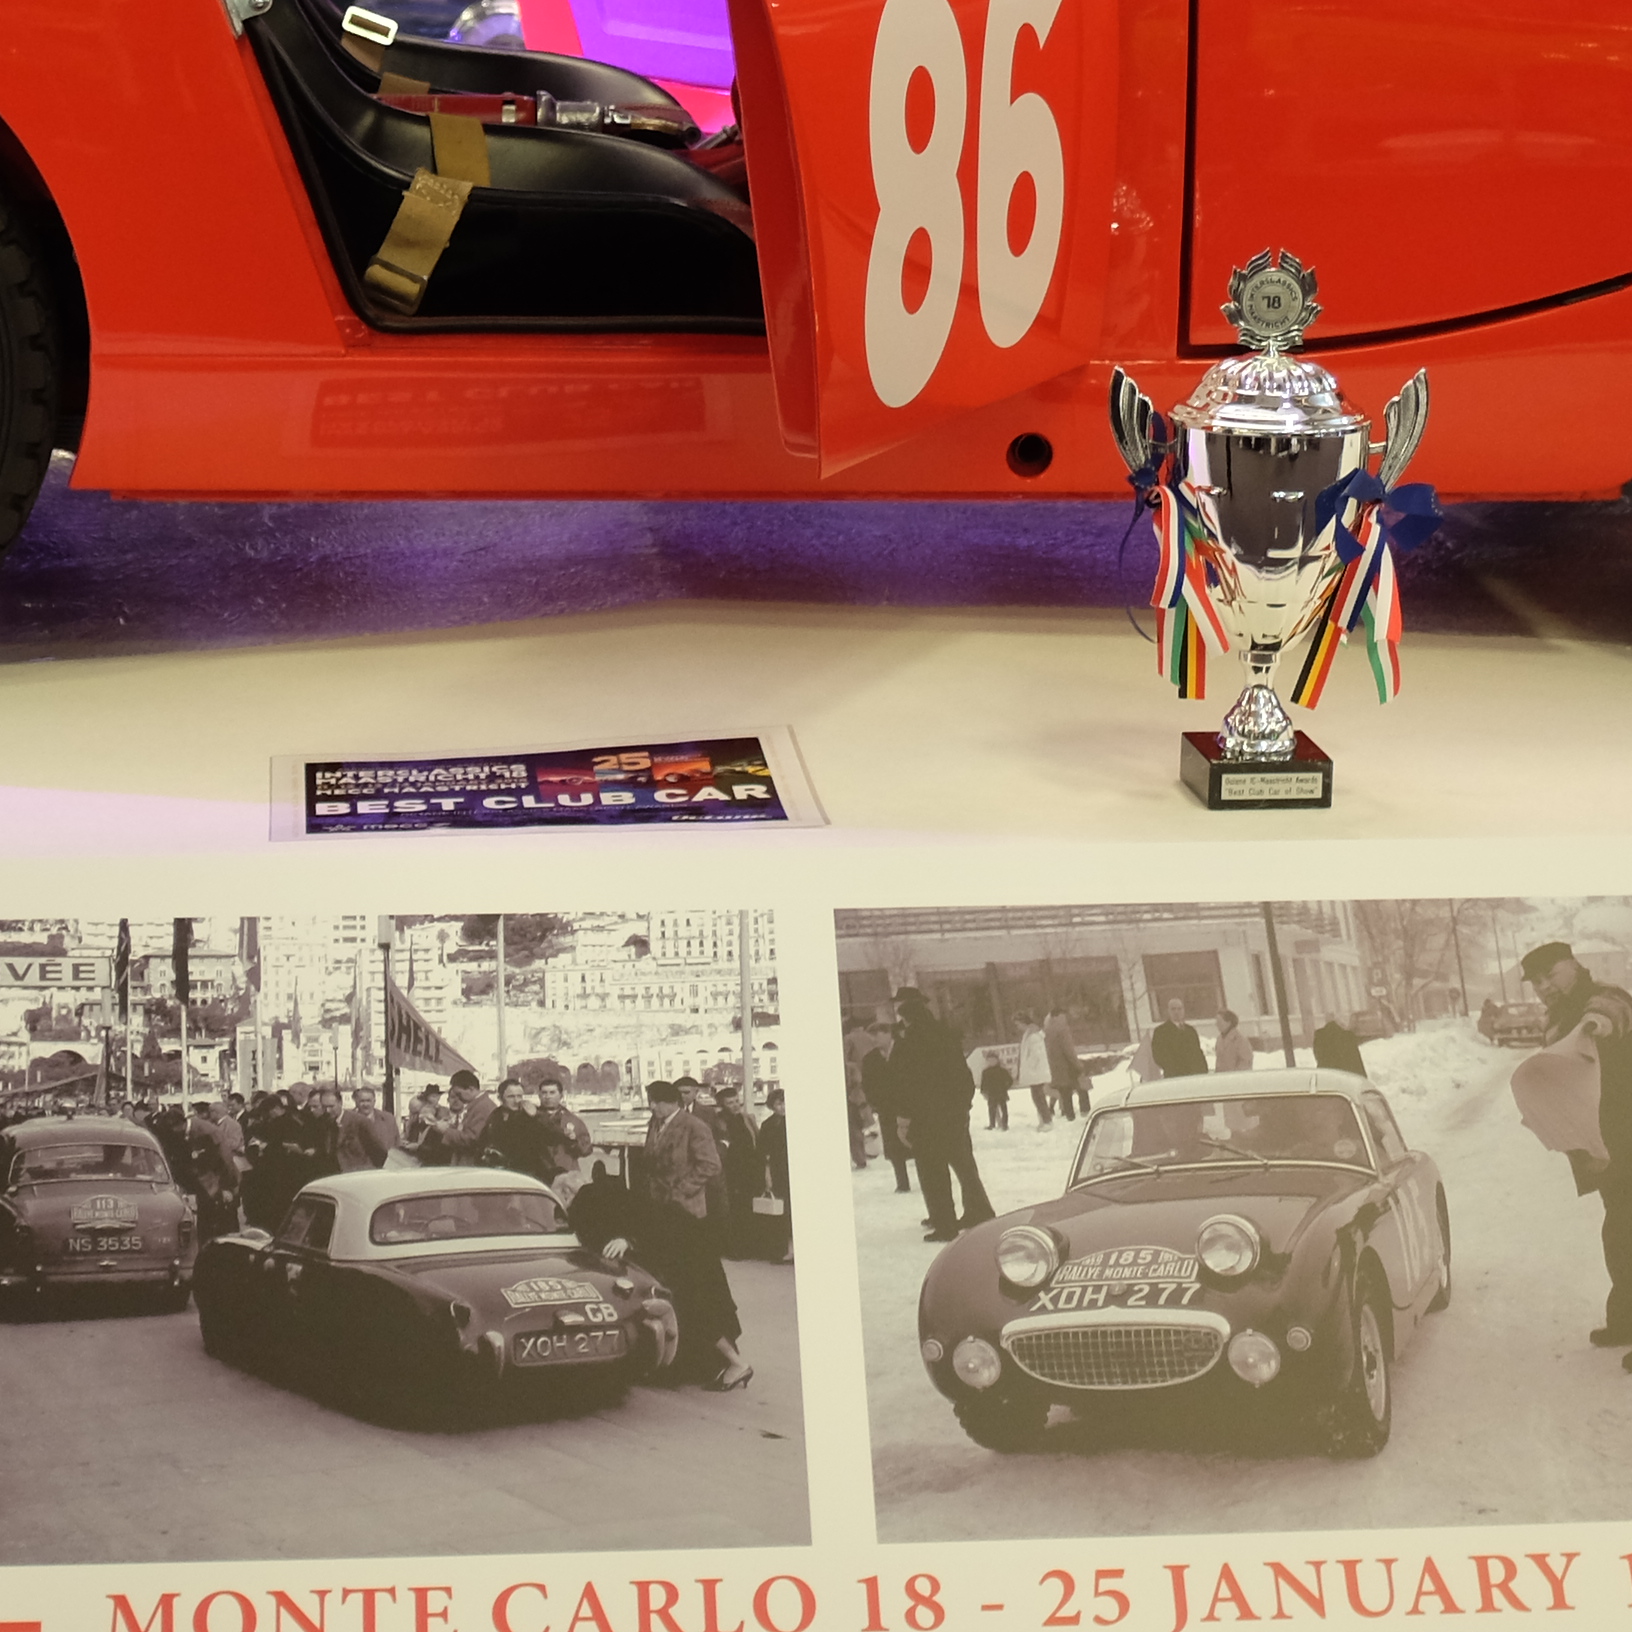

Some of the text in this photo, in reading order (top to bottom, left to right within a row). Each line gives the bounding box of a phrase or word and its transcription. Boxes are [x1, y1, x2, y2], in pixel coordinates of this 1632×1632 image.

[592, 751, 653, 771] 25
[315, 797, 465, 816] BEST
[483, 791, 636, 809] CLUB
[654, 784, 771, 803] CAR
[69, 1236, 142, 1252] NS 3535
[1108, 1250, 1154, 1266] 185
[1058, 1264, 1102, 1281] RALLYE
[1029, 1282, 1201, 1312] XOH 277
[585, 1303, 618, 1322] GB
[519, 1330, 619, 1359] XOH 277
[106, 1586, 459, 1632] MONTE
[492, 1575, 818, 1632] CARLO
[856, 1572, 946, 1632] 18
[1038, 1566, 1132, 1627] 25
[1162, 1552, 1581, 1632] JANUARY
